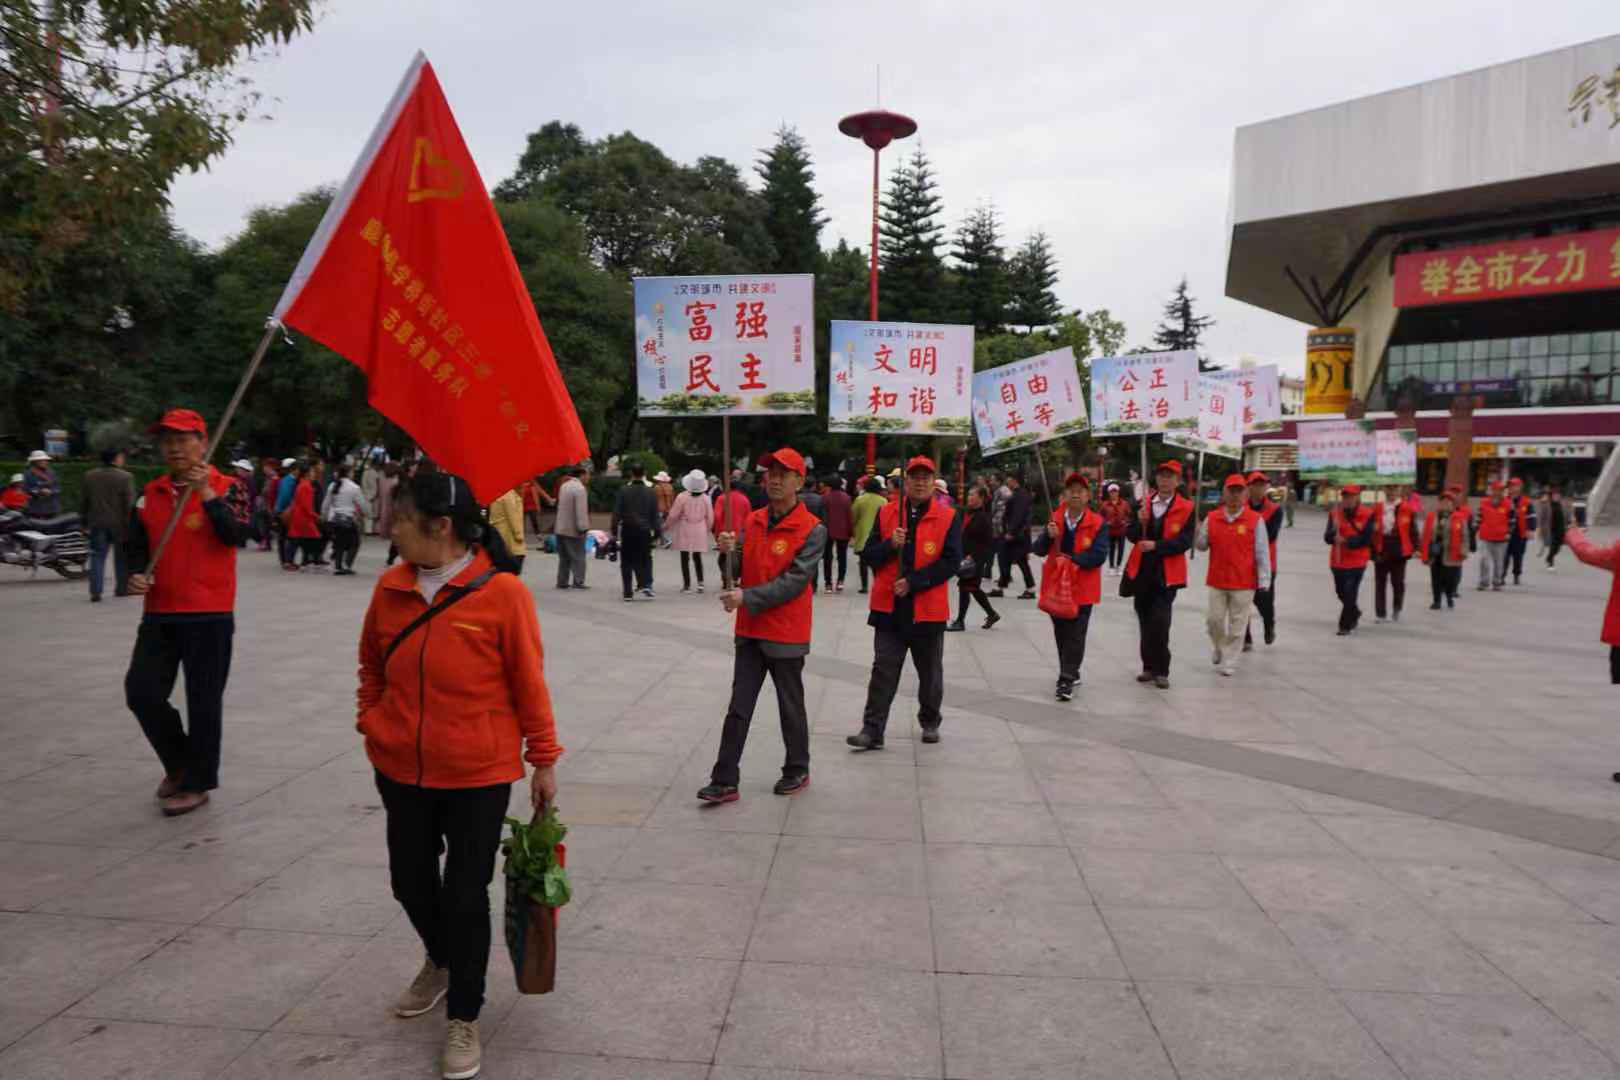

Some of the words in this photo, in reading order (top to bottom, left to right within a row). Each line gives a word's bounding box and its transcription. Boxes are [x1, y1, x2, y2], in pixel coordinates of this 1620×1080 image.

[1421, 241, 1586, 297] 举全市之力
[685, 300, 769, 341] 富强
[686, 352, 768, 392] 民主
[868, 344, 937, 376] 文明
[1001, 374, 1047, 404] 自由
[1120, 369, 1168, 391] 公正
[866, 386, 937, 415] 和谐
[1120, 398, 1168, 419] 法治
[1005, 402, 1055, 433] 平等
